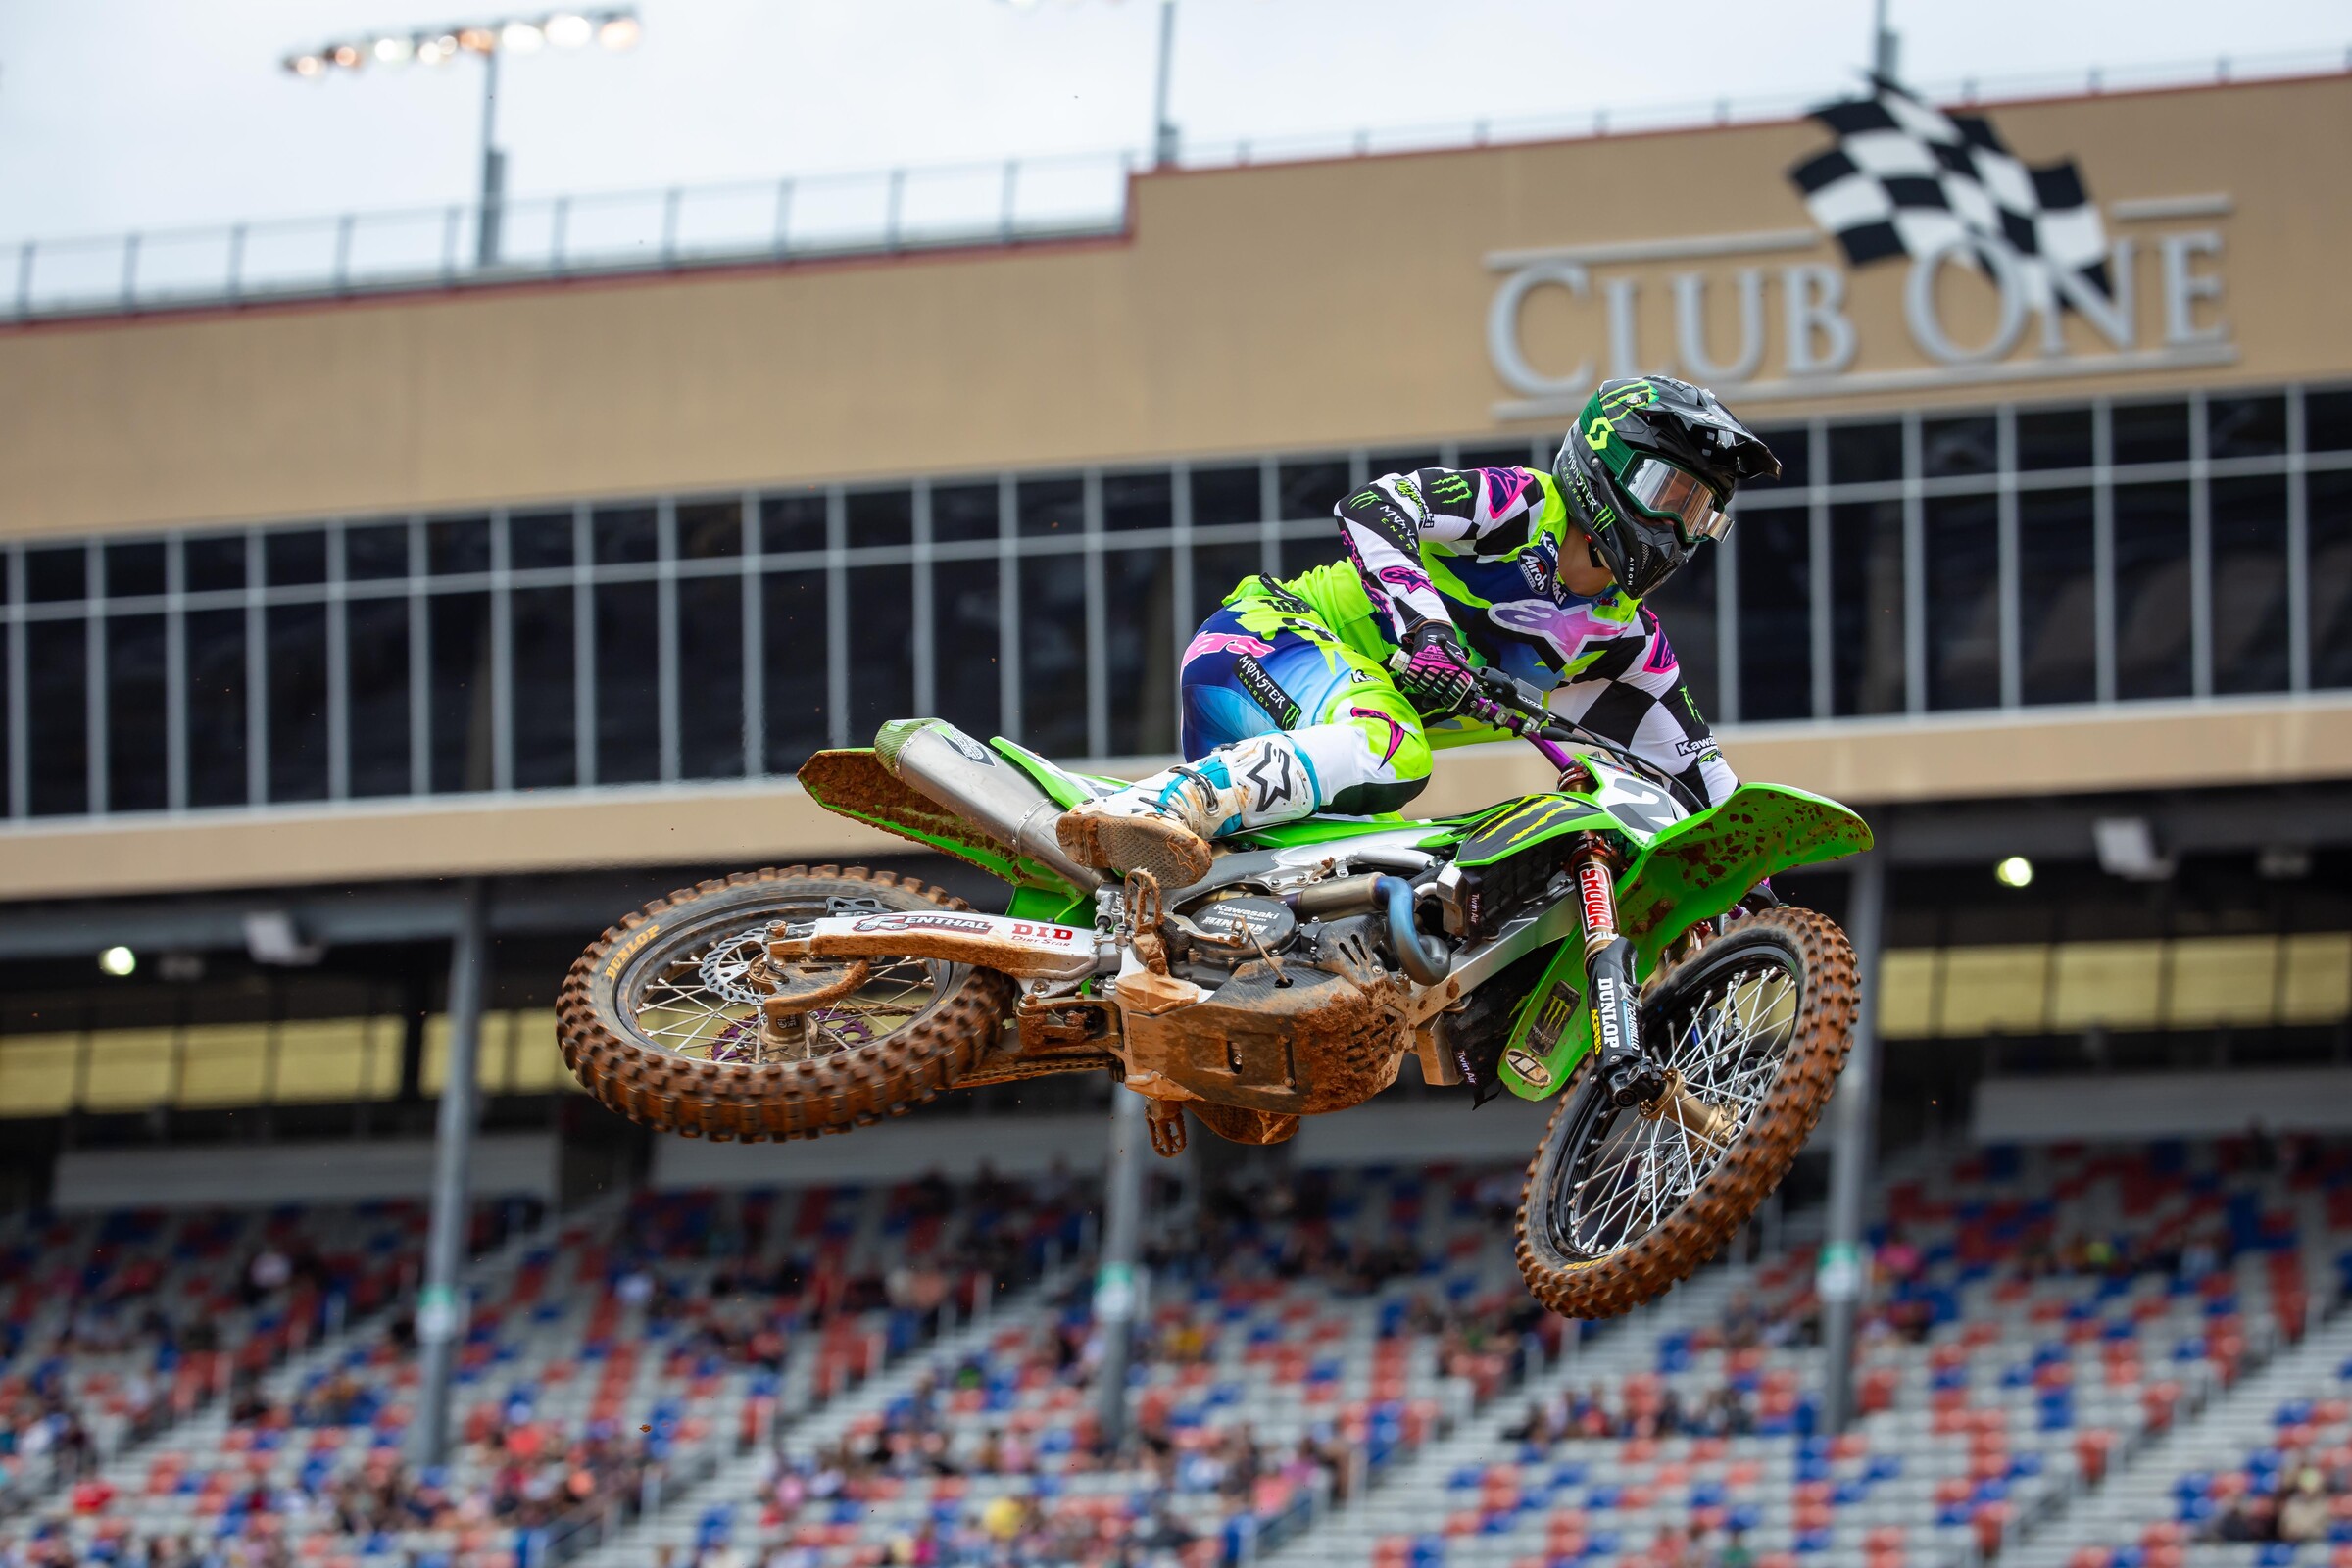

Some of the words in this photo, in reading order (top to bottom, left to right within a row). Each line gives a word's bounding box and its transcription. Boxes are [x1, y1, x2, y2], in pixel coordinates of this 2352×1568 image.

[1487, 260, 1858, 394] CLUB
[1904, 229, 2234, 366] ONE
[1381, 517, 1413, 550] ENER
[1521, 554, 1548, 591] Airoh
[1238, 672, 1270, 708] ENERGY
[1239, 655, 1286, 709] MONSTER
[1677, 736, 1717, 755] Kawa
[1213, 904, 1280, 920] Kawasaki
[1471, 894, 1480, 912] Twin
[1580, 868, 1615, 931] SHOWA
[856, 915, 991, 932] RENTHAL
[1470, 912, 1479, 924] Air
[605, 924, 660, 981] DUNLOP
[1597, 977, 1620, 1049] DUNLOP
[1457, 1051, 1470, 1071] Twin
[1466, 1072, 1477, 1084] Air
